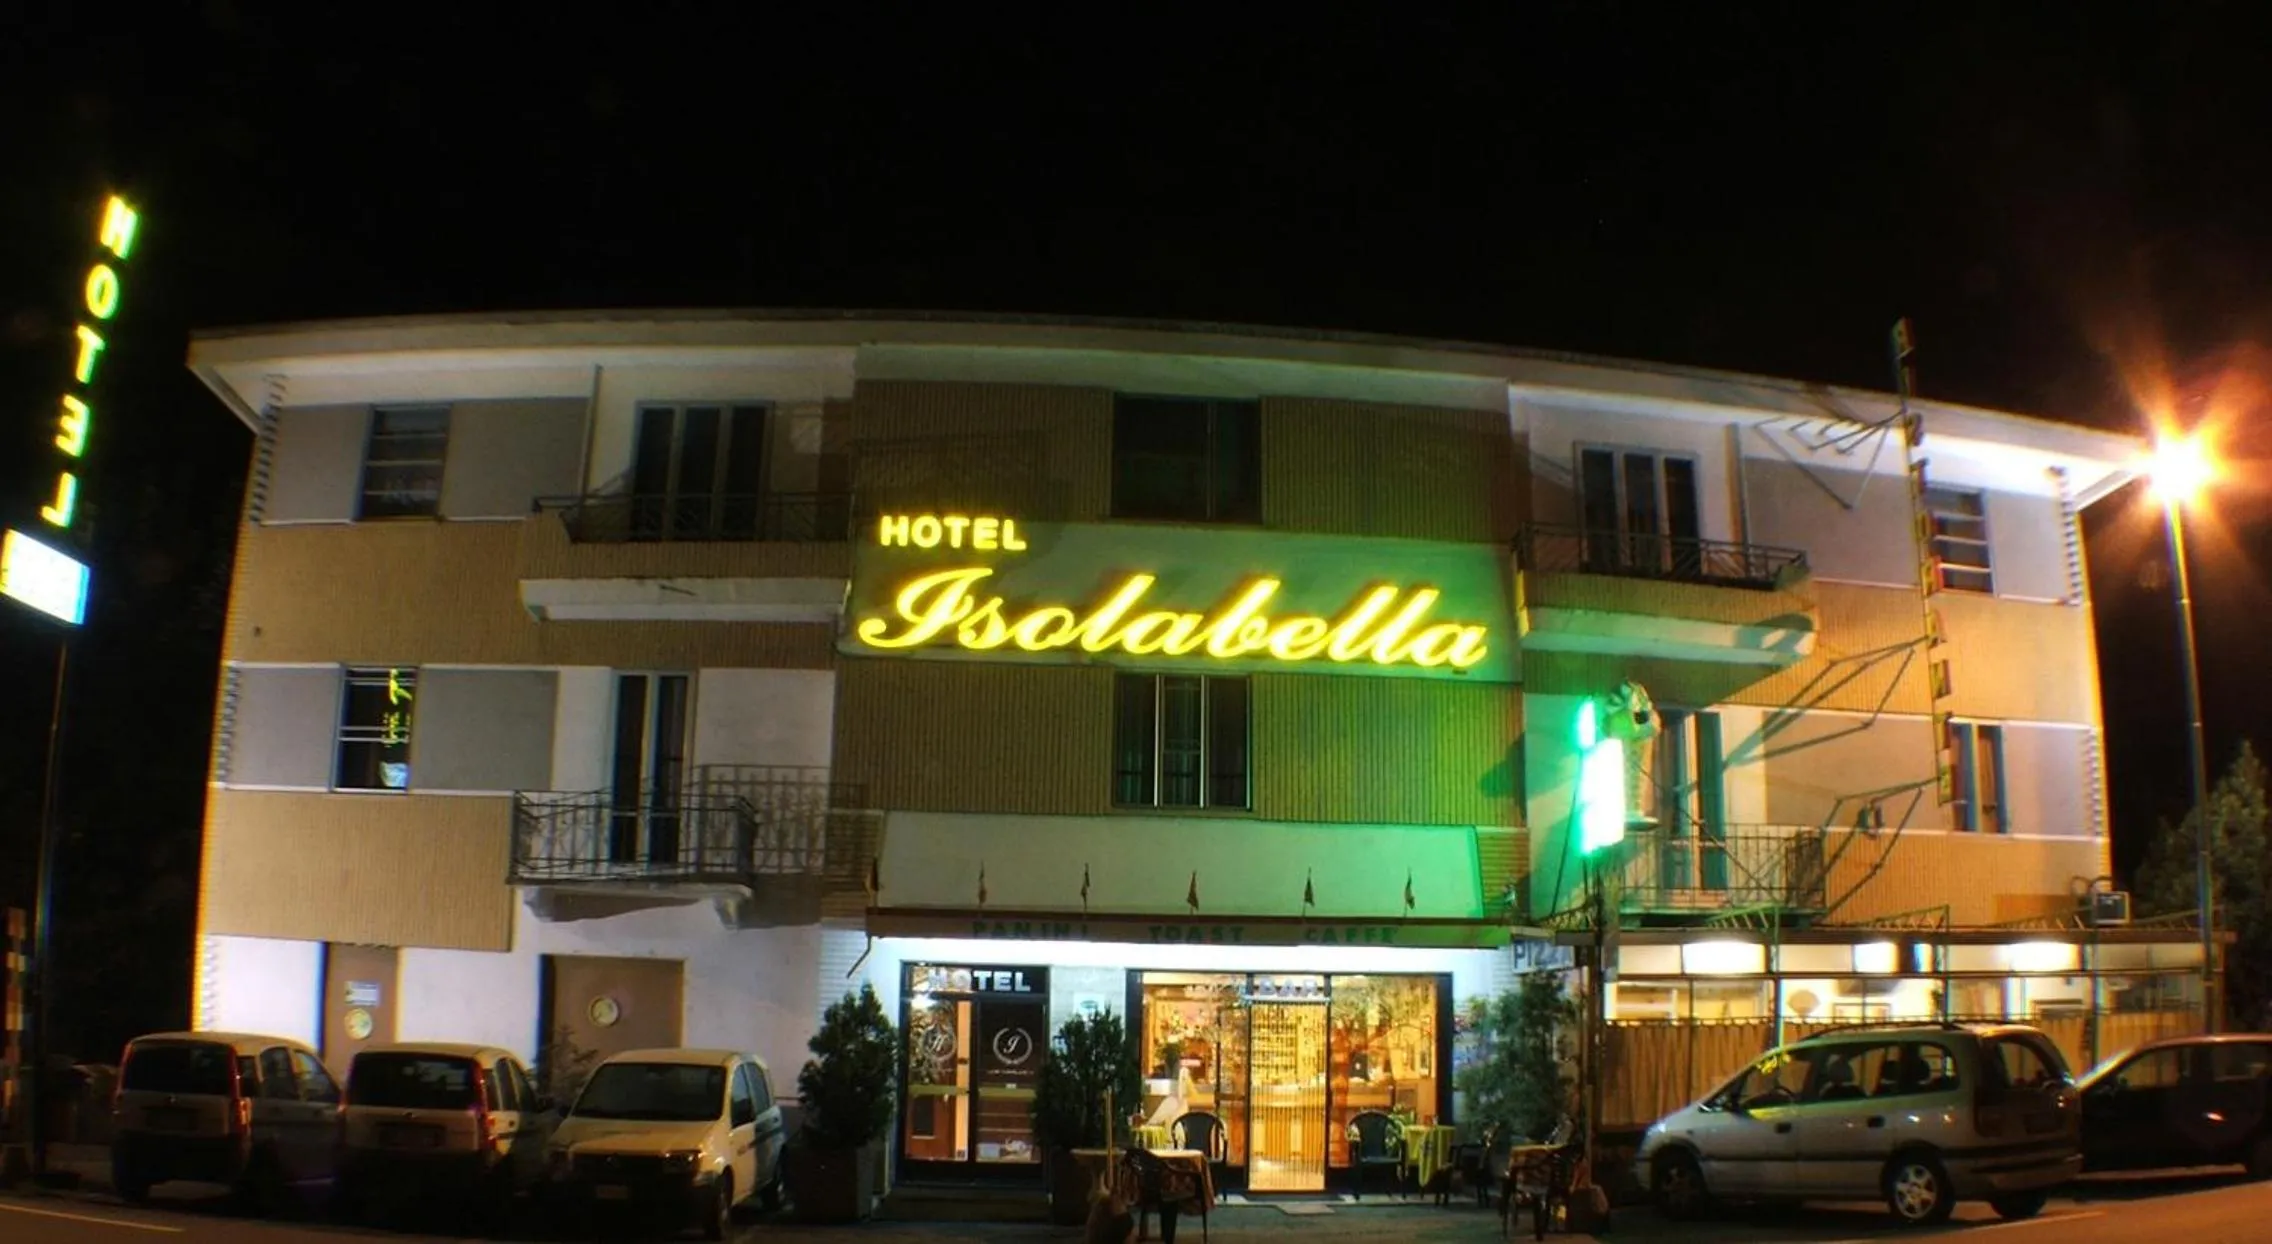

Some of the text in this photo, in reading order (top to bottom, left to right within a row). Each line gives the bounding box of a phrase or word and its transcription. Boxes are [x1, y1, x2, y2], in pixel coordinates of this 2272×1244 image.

[880, 514, 1027, 550] HOTEL
[859, 567, 1488, 668] Isolabella
[1148, 925, 1244, 944] TOAST
[928, 966, 1031, 992] HOTEL
[1258, 978, 1318, 996] BAR
